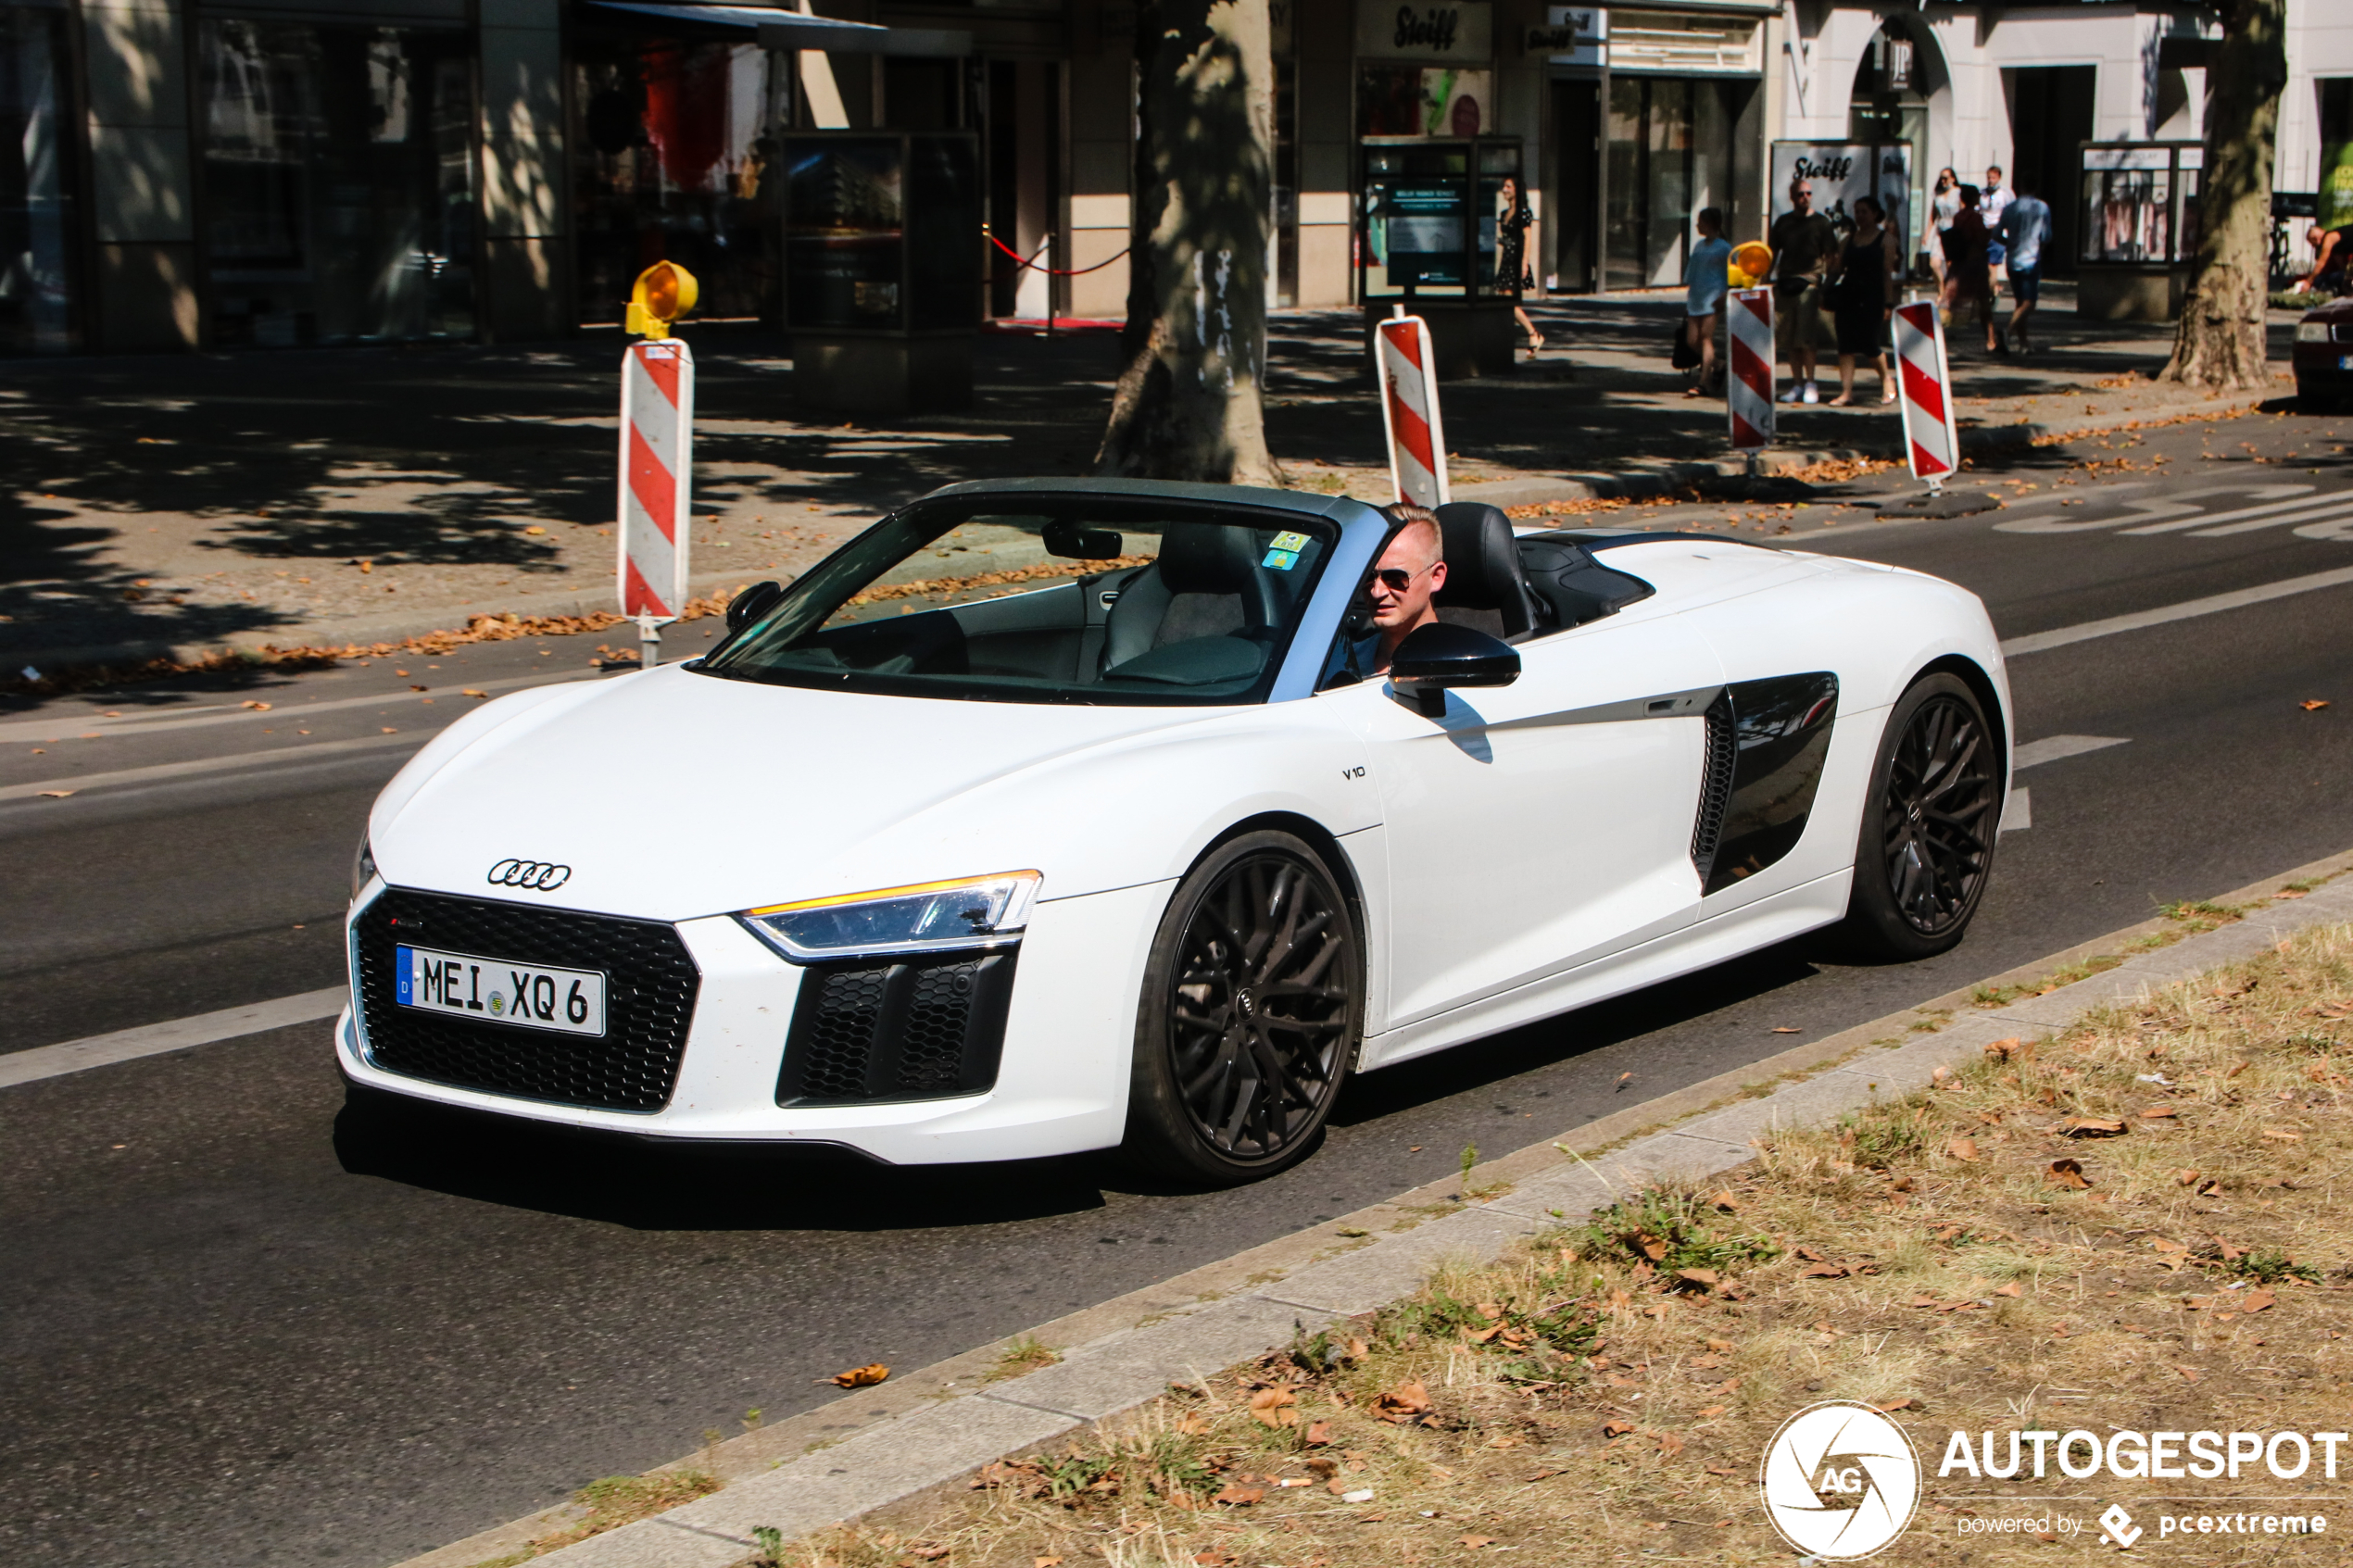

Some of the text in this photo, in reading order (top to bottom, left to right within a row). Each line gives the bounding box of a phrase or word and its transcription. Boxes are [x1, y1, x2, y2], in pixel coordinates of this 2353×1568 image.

[1394, 6, 1458, 51] Steiff
[1793, 157, 1853, 182] Steiff
[1341, 766, 1365, 781] V10
[401, 981, 409, 994] D
[423, 957, 588, 1024] MEI XQ 6
